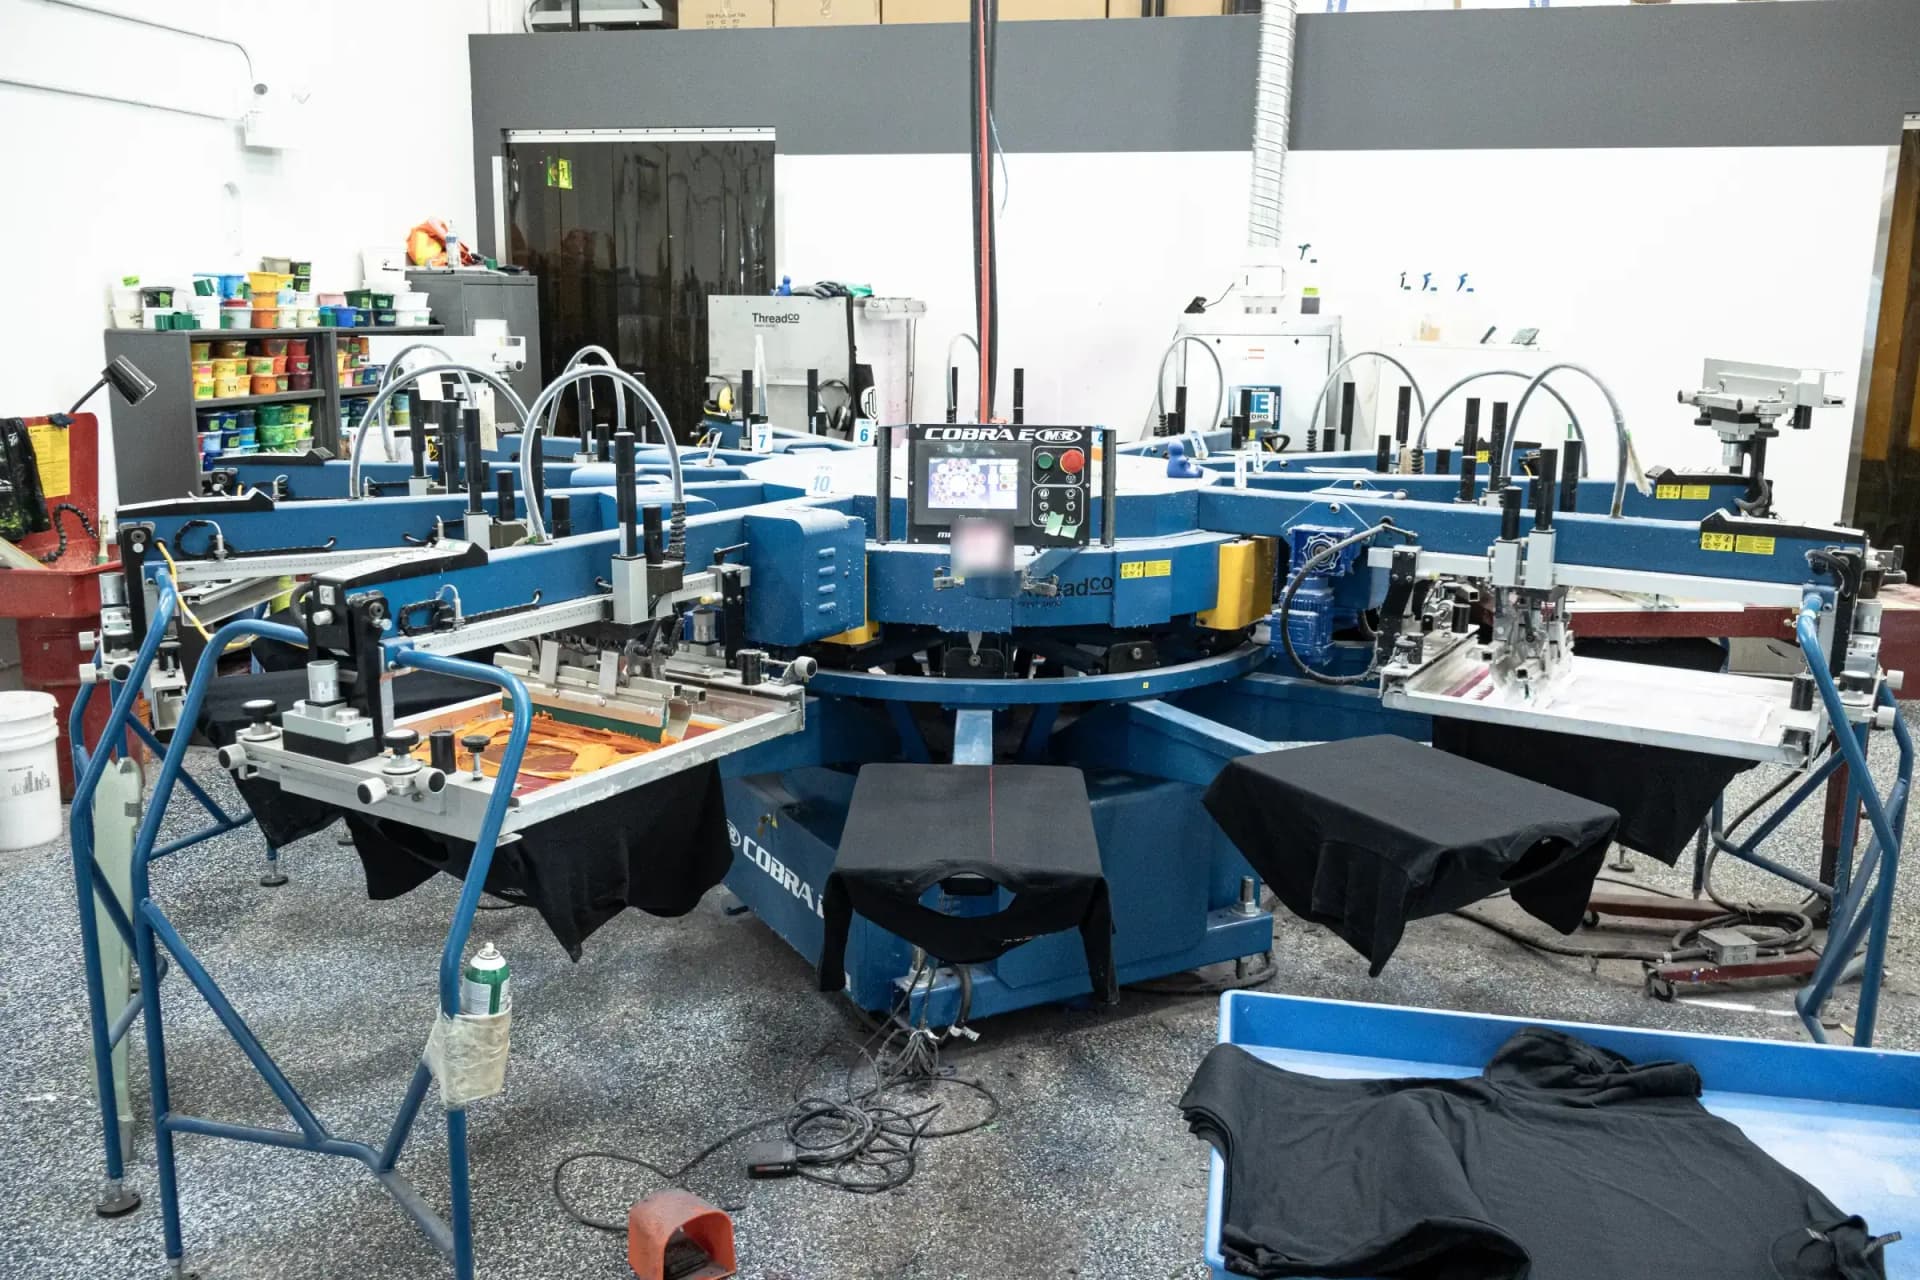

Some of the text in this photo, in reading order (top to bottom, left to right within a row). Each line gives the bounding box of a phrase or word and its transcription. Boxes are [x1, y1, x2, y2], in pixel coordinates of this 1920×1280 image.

[752, 312, 800, 323] Threadco
[860, 429, 869, 442] 6
[924, 428, 1014, 441] COBRA
[1018, 429, 1036, 441] E
[758, 435, 767, 449] 7
[813, 475, 831, 492] 10
[743, 835, 814, 911] COBRA
